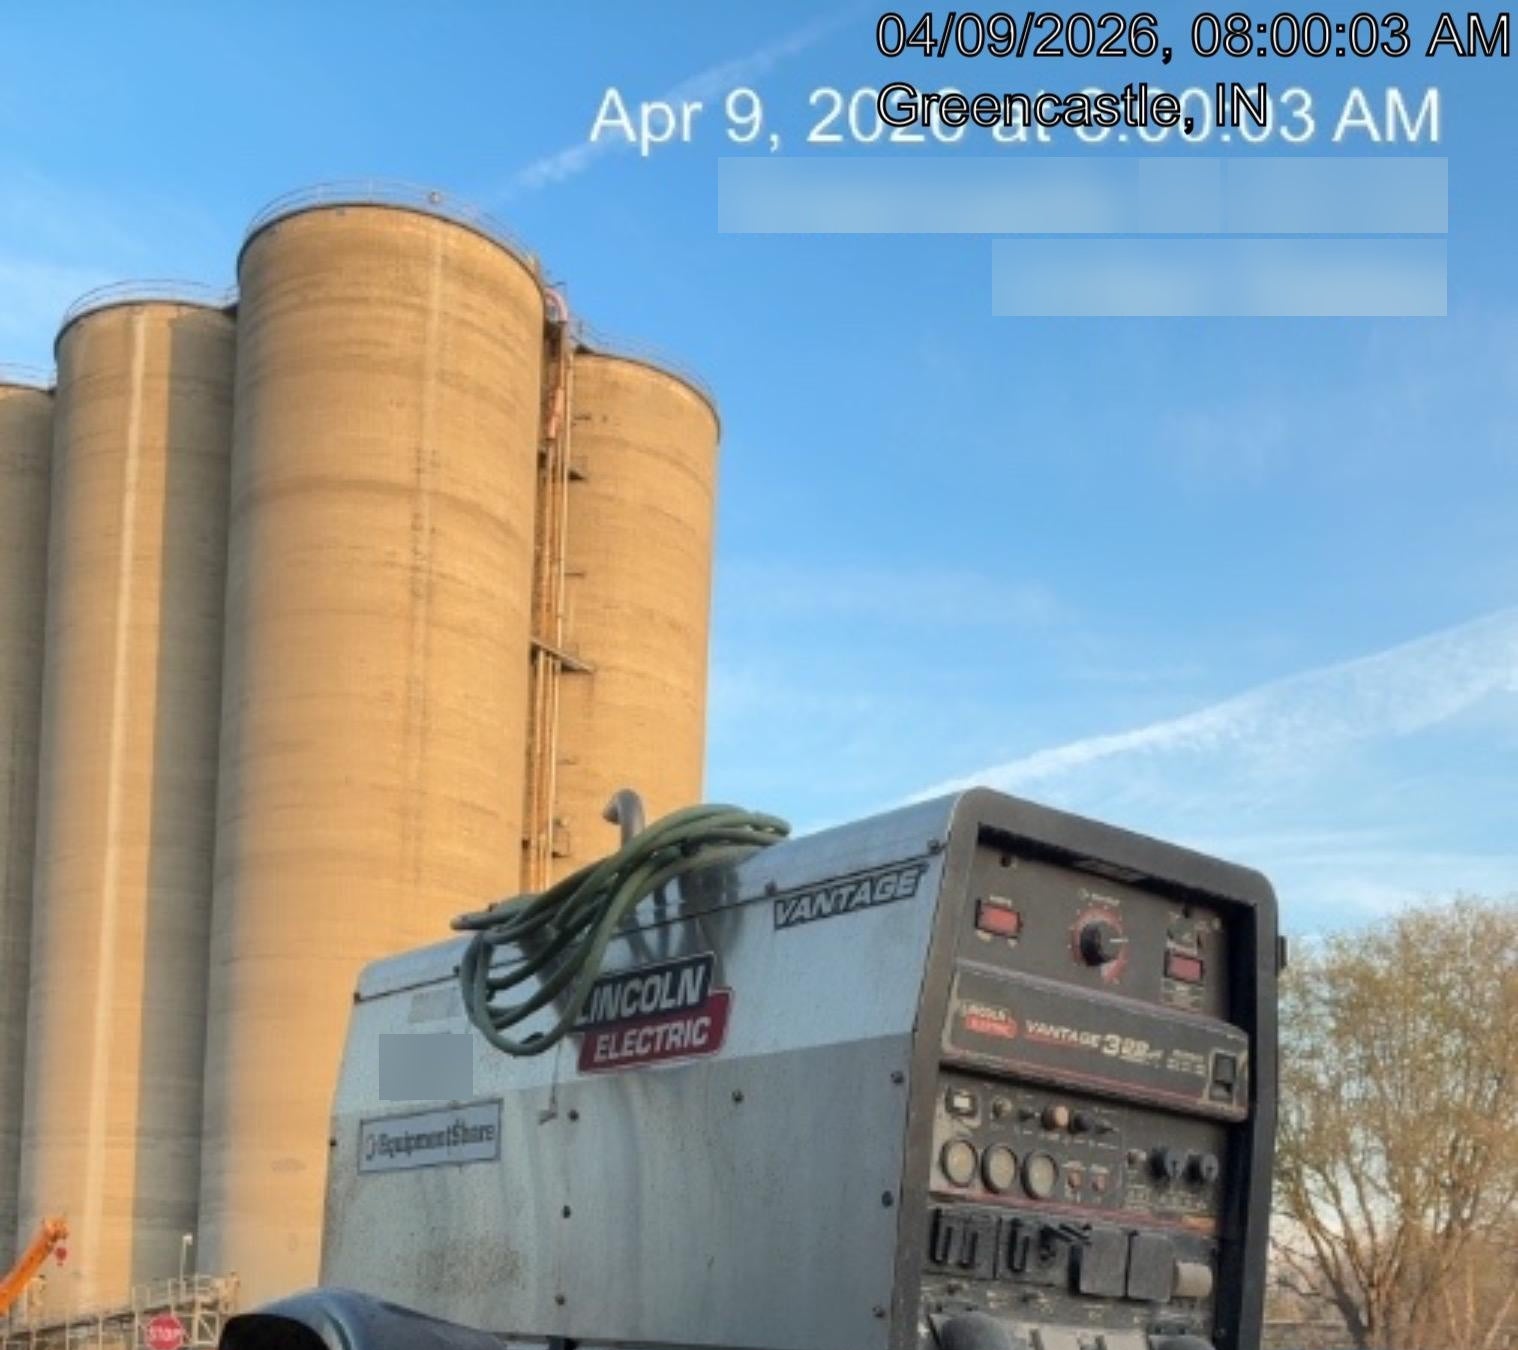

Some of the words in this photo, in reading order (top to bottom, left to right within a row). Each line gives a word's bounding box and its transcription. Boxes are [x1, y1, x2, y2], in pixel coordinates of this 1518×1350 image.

[775, 868, 922, 926] VANTAGE
[593, 1015, 713, 1062] ELECTRIC
[1025, 1019, 1101, 1048] VANTAGE
[377, 1118, 497, 1158] EquipmentShare
[149, 1325, 182, 1342] STOP
